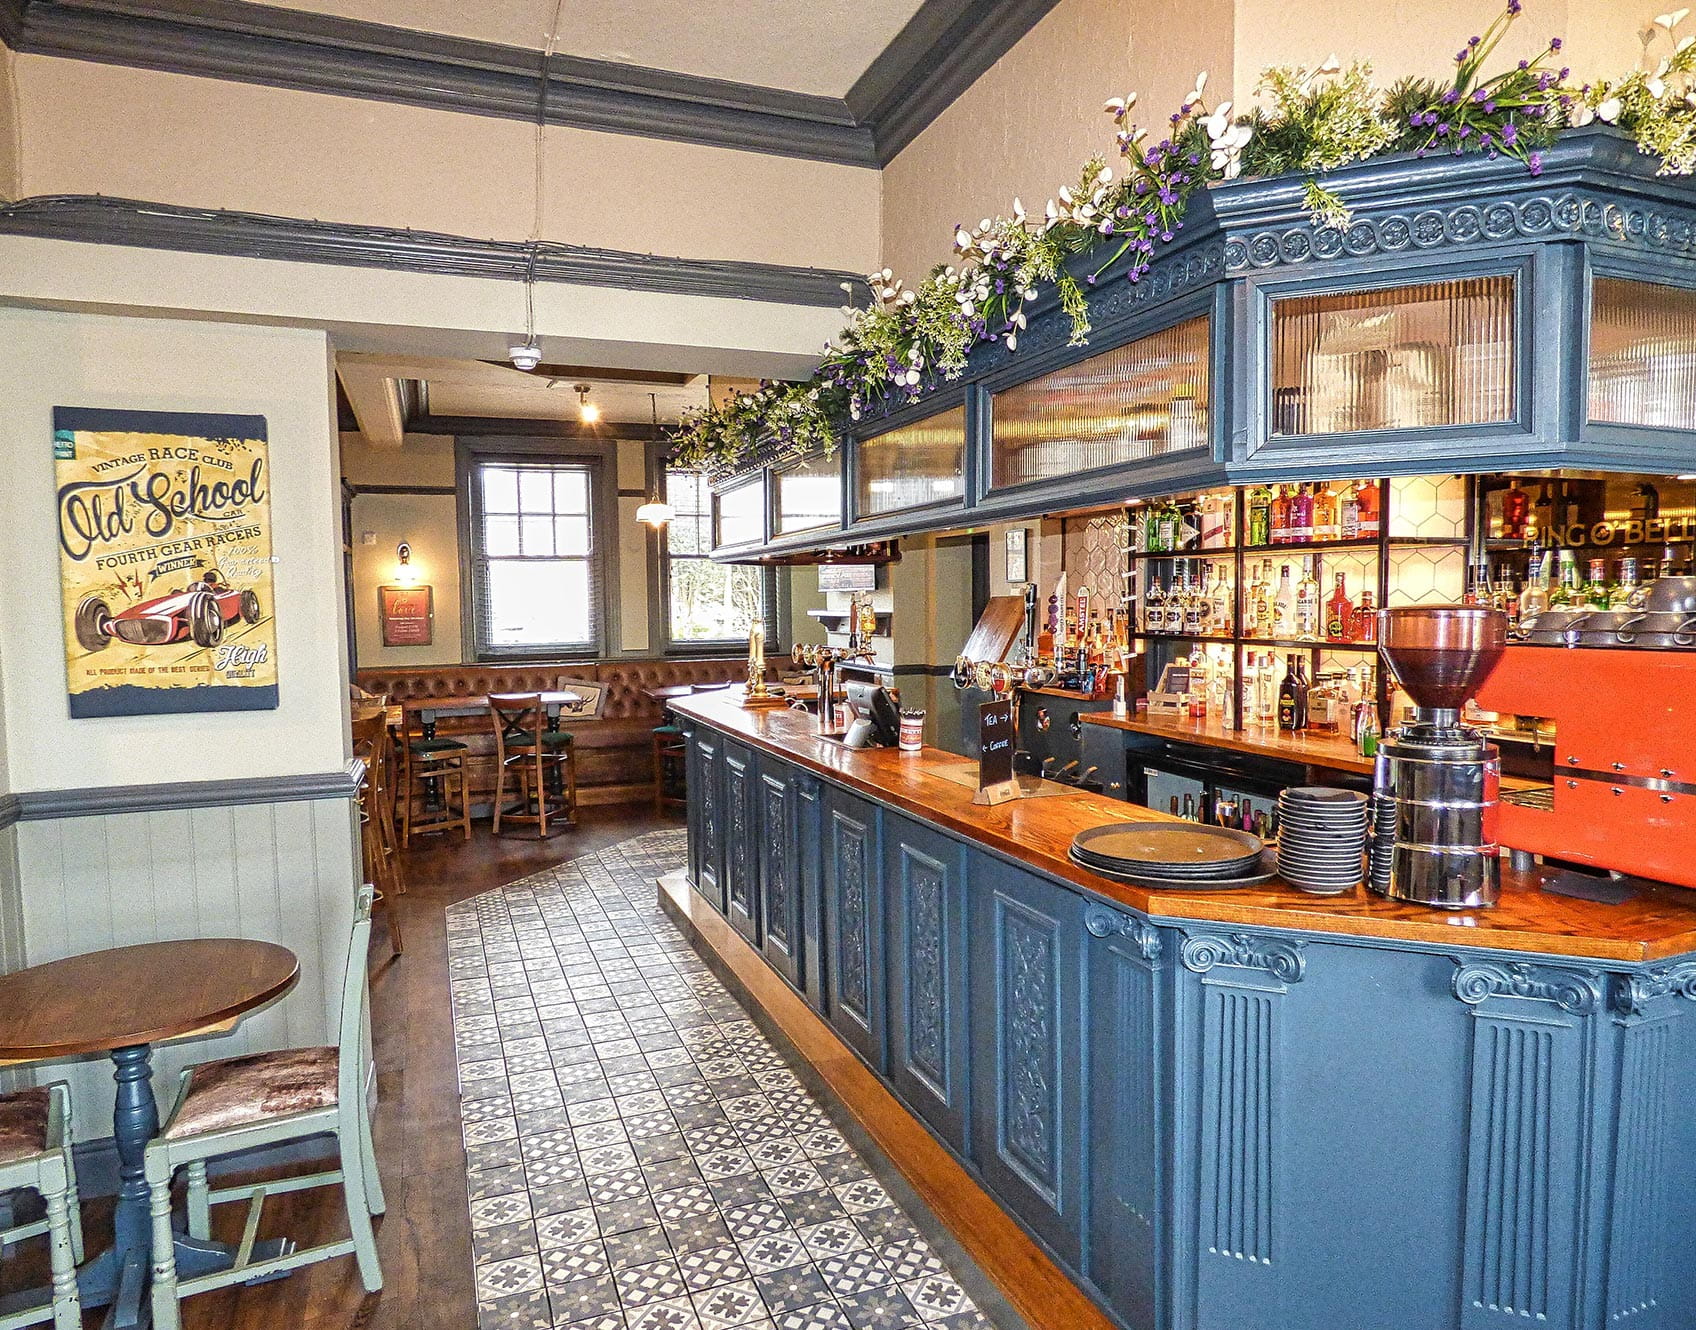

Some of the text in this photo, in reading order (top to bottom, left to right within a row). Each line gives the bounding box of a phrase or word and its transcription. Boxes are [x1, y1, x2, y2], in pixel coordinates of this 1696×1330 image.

[92, 453, 147, 473] VINTAGE
[148, 447, 199, 461] RACE
[202, 455, 233, 471] CLUB
[58, 458, 265, 560] Old School
[95, 526, 262, 571] FOURTH GEAR RACERS
[1078, 597, 1087, 633] AMSTEL
[214, 643, 268, 671] High
[984, 713, 998, 727] TEA
